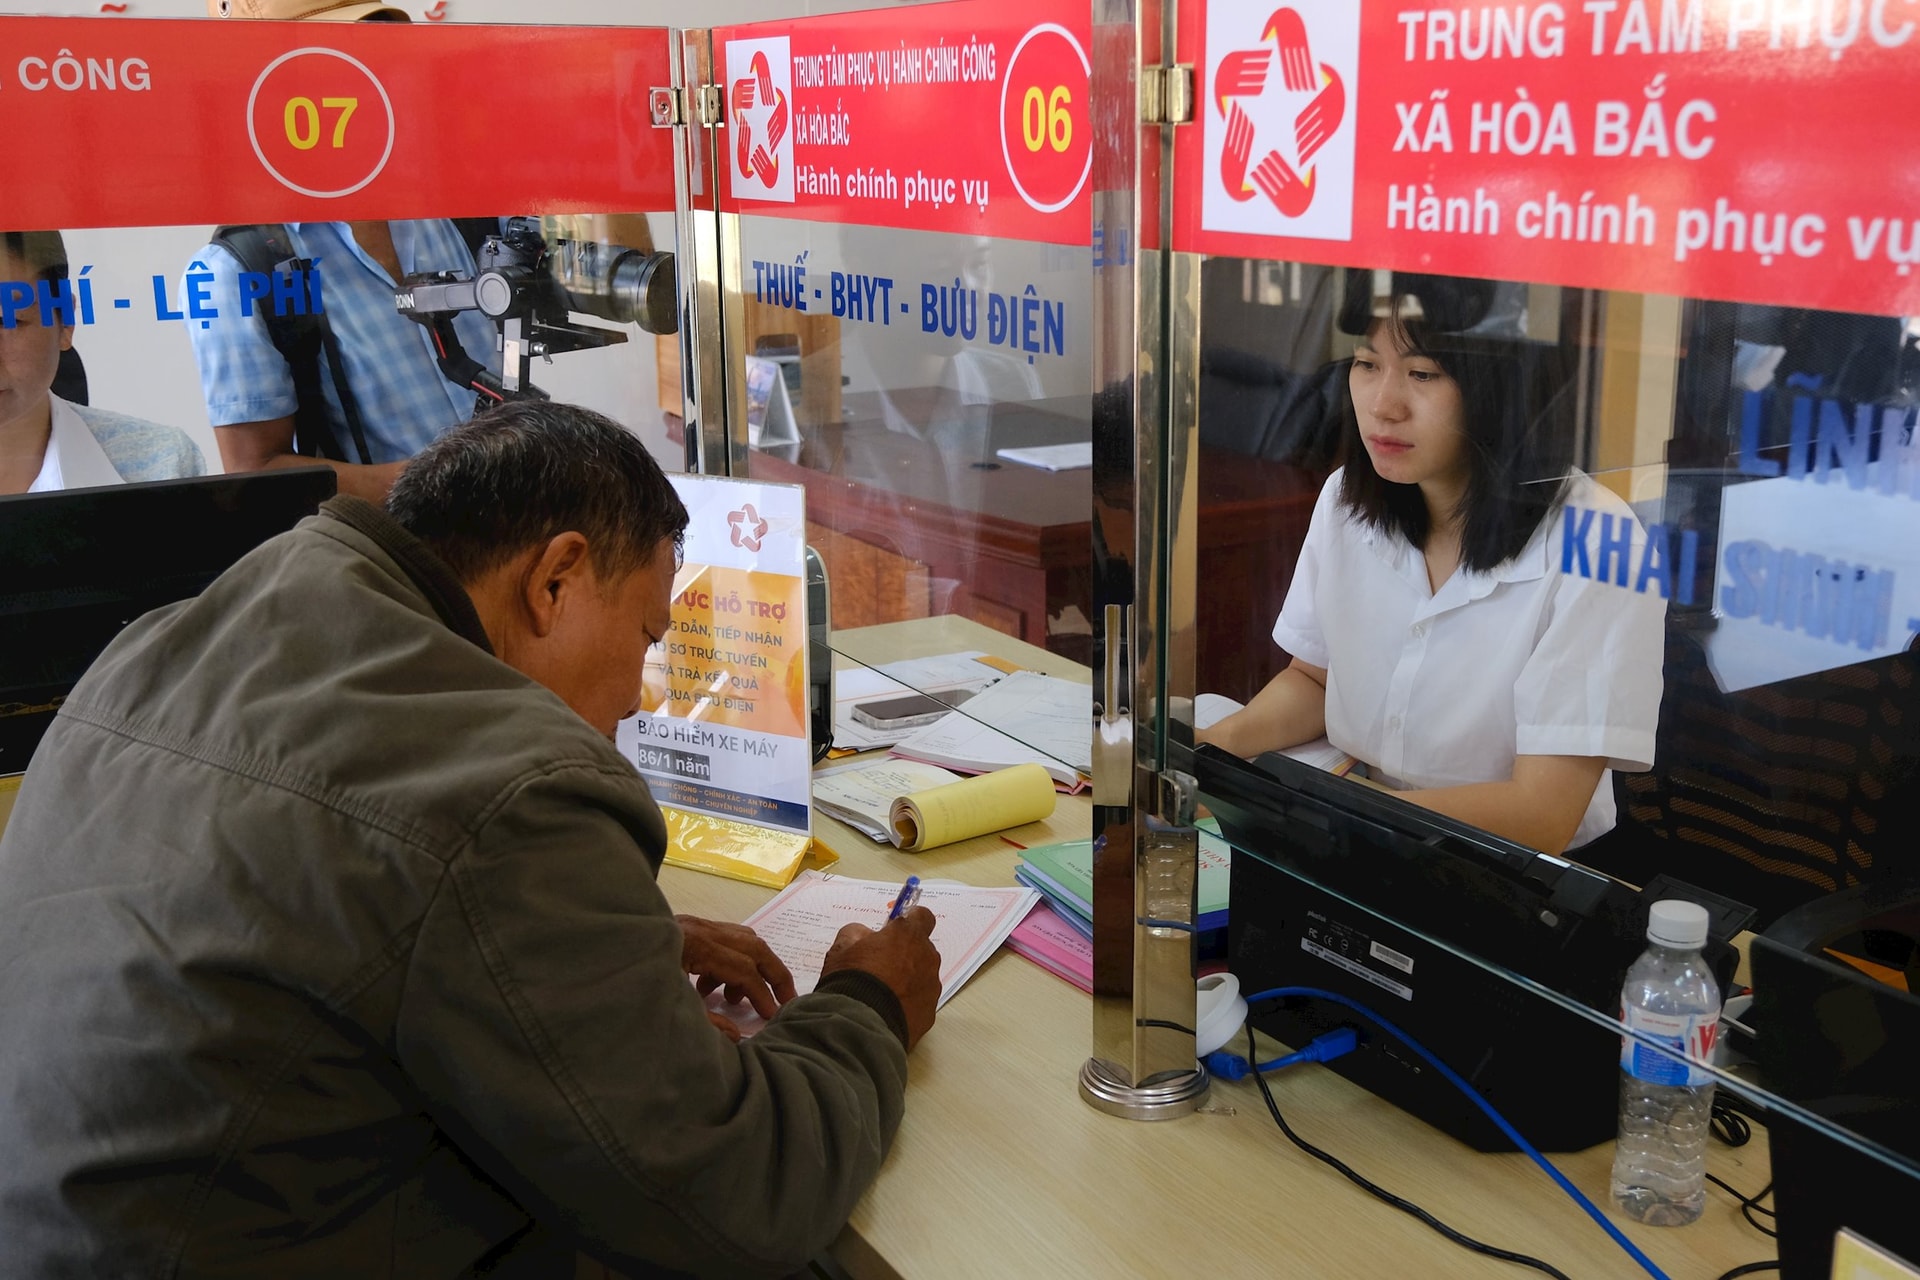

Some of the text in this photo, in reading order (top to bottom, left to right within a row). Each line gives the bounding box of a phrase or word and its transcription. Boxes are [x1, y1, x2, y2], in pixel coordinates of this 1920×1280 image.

[1397, 3, 1566, 62] TRUNG
[1726, 0, 1916, 61] PHỤC
[18, 48, 152, 91] CÔNG
[794, 34, 996, 92] TRUNG TÂM PHỤC VỤ HÀNH CHÍNH CÔNG
[284, 97, 358, 150] 07
[795, 98, 851, 146] XÃ HÒA BẮC
[1022, 85, 1073, 153] 06
[1392, 72, 1717, 160] XÃ HÒA BẮC
[796, 165, 989, 213] Hành chính phục vụ
[1387, 183, 1920, 276] Hành chính phục vụ
[0, 265, 95, 329] PHÍ
[152, 261, 218, 329] LỆ
[238, 257, 324, 318] PHÍ
[752, 251, 809, 312] THUẾ
[830, 271, 894, 326] BHYT
[920, 277, 977, 341] BƯU
[987, 284, 1064, 365] ĐIỆN
[1561, 505, 1699, 606] KHAI
[714, 591, 742, 614] HỖ
[747, 602, 786, 624] TRỢ
[670, 643, 687, 655] SƠ
[690, 646, 723, 662] TRỰC
[725, 651, 768, 668] TUYẾN
[680, 619, 711, 638] DẪN,
[714, 625, 741, 640] TIẾP
[745, 632, 783, 648] NHẬN
[664, 687, 691, 702] QUA
[724, 698, 754, 712] ĐIỆN
[677, 666, 701, 681] TRẢ
[731, 675, 759, 690] QUẢ
[638, 717, 778, 759] BẢO HIỂM XE MÁY
[639, 749, 710, 776] 86/1 năm
